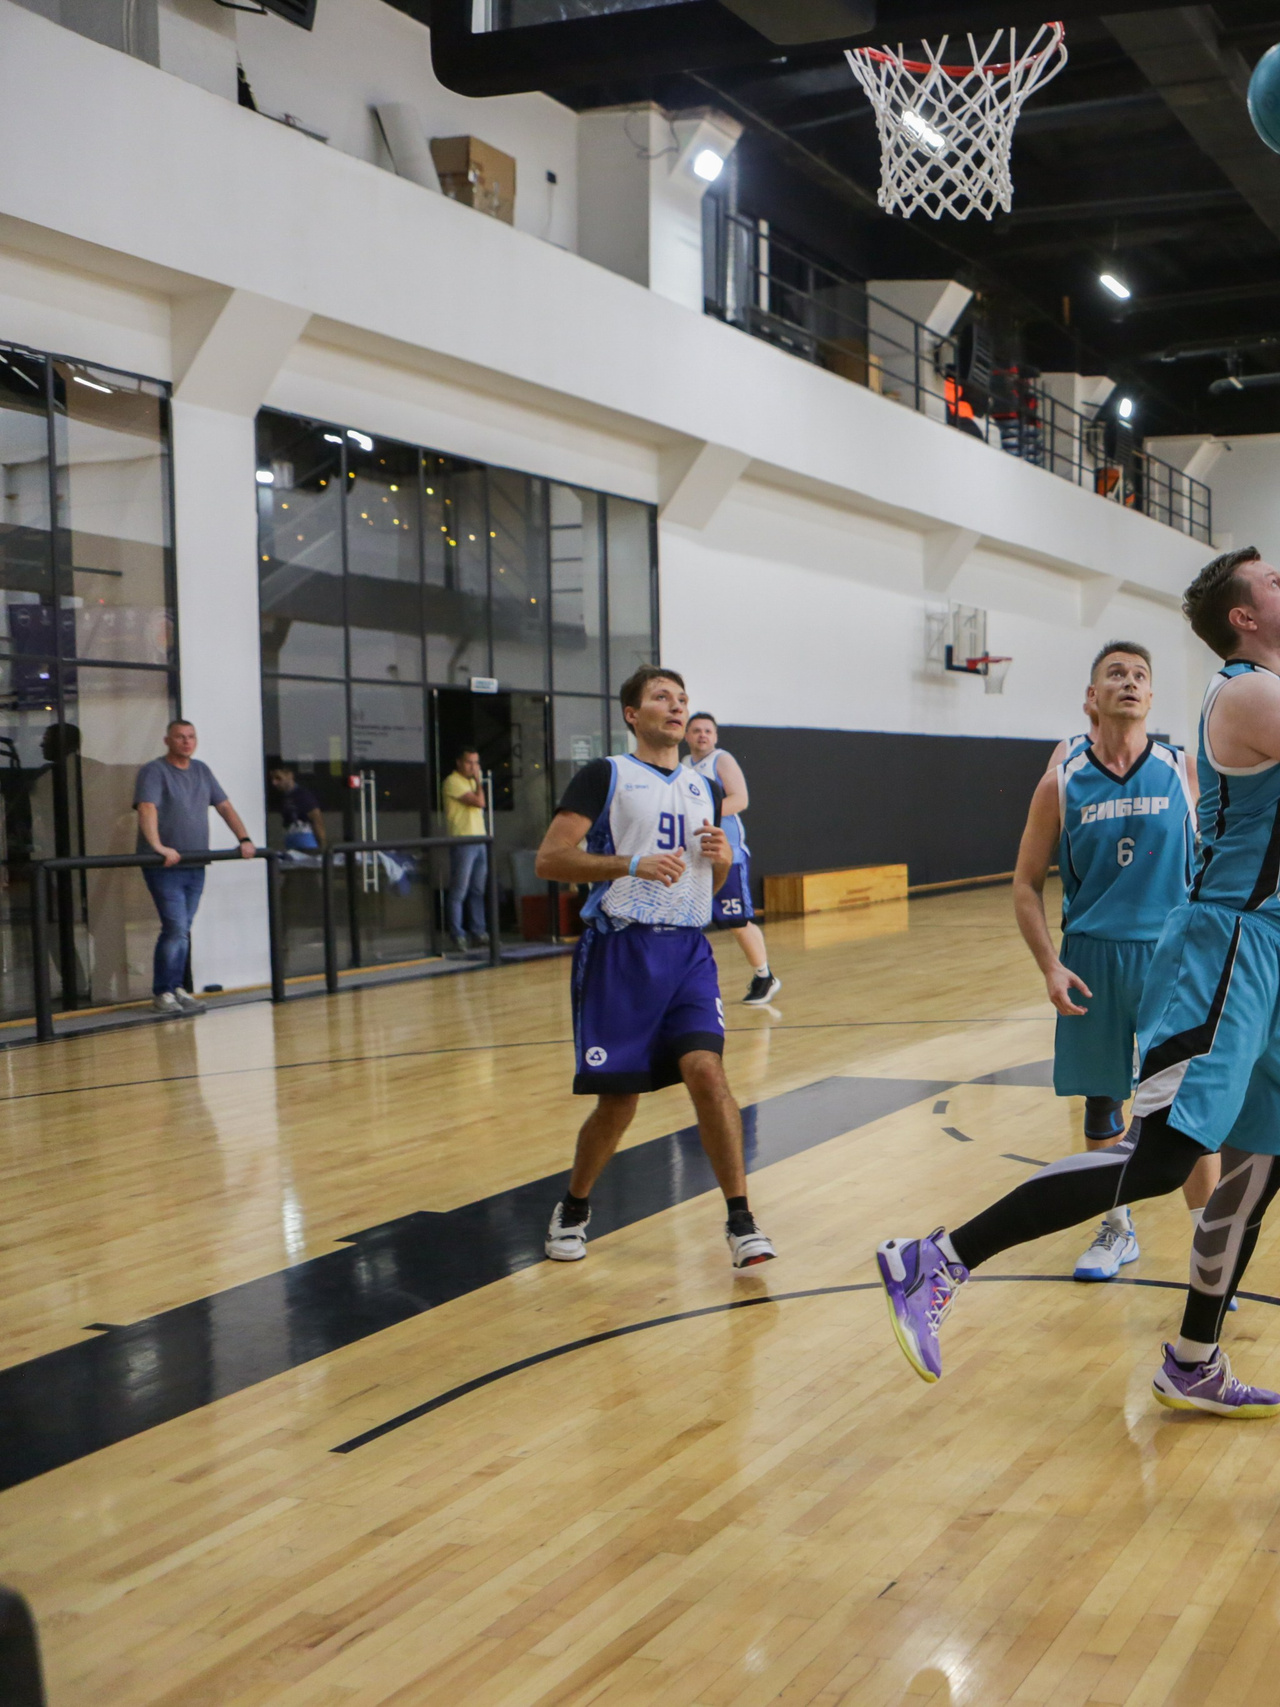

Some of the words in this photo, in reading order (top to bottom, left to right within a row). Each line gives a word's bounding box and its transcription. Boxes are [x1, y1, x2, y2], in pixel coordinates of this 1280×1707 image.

[1080, 796, 1169, 825] СИБУР
[656, 811, 687, 851] 91
[1117, 837, 1135, 868] 6
[721, 898, 742, 915] 25
